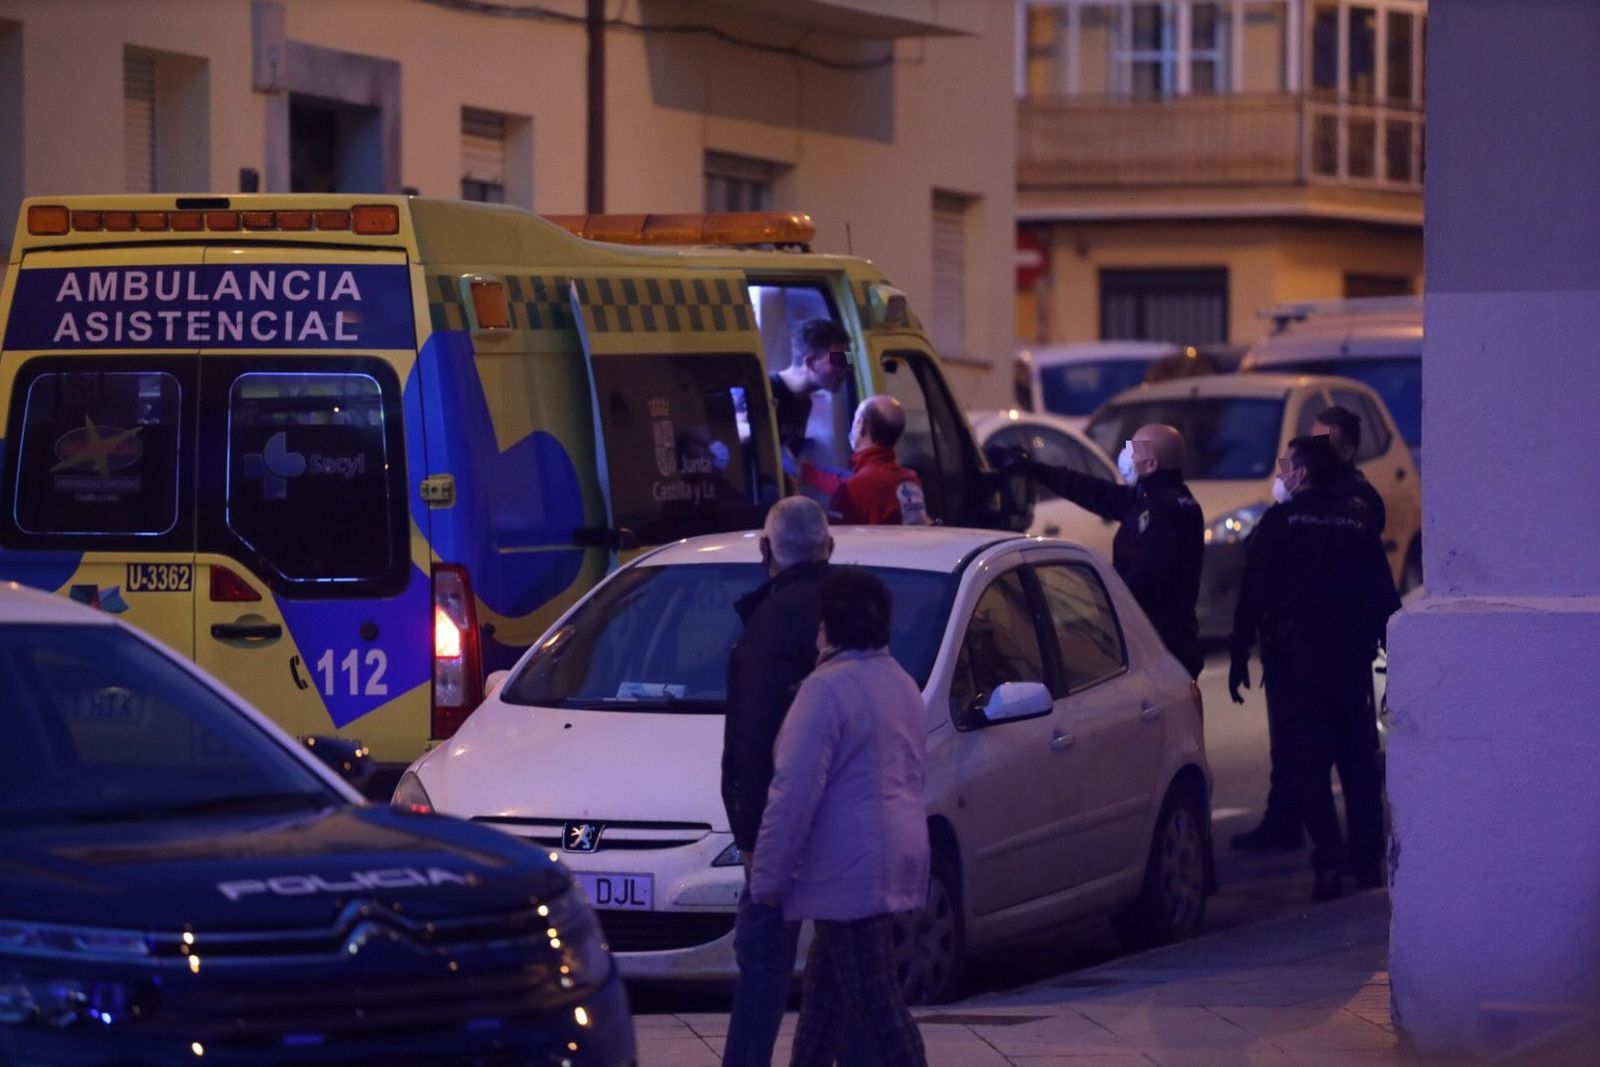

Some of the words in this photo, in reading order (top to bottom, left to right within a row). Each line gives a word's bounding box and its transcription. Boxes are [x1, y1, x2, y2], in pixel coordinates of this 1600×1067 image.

[56, 271, 362, 302] AMBULANCIA
[53, 310, 359, 342] ASISTENCIAL
[309, 453, 364, 480] Sacyl
[129, 563, 190, 591] U-3362
[317, 649, 388, 695] 112
[217, 868, 469, 901] POLICIA
[597, 877, 645, 906] DJL
